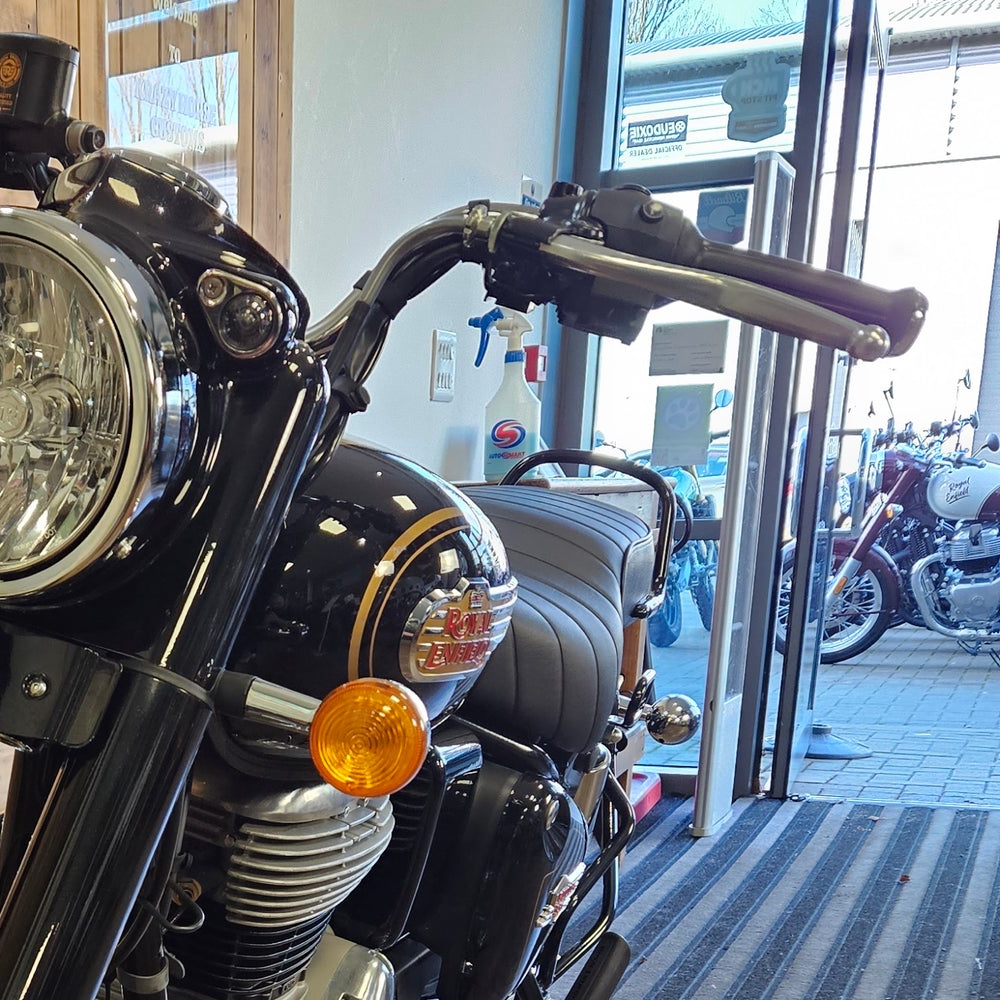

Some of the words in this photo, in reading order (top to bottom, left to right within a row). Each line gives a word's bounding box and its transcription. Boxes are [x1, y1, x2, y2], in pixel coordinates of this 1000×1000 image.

[948, 476, 970, 492] Royal
[945, 486, 969, 503] Enfield
[443, 606, 494, 640] ROYAL
